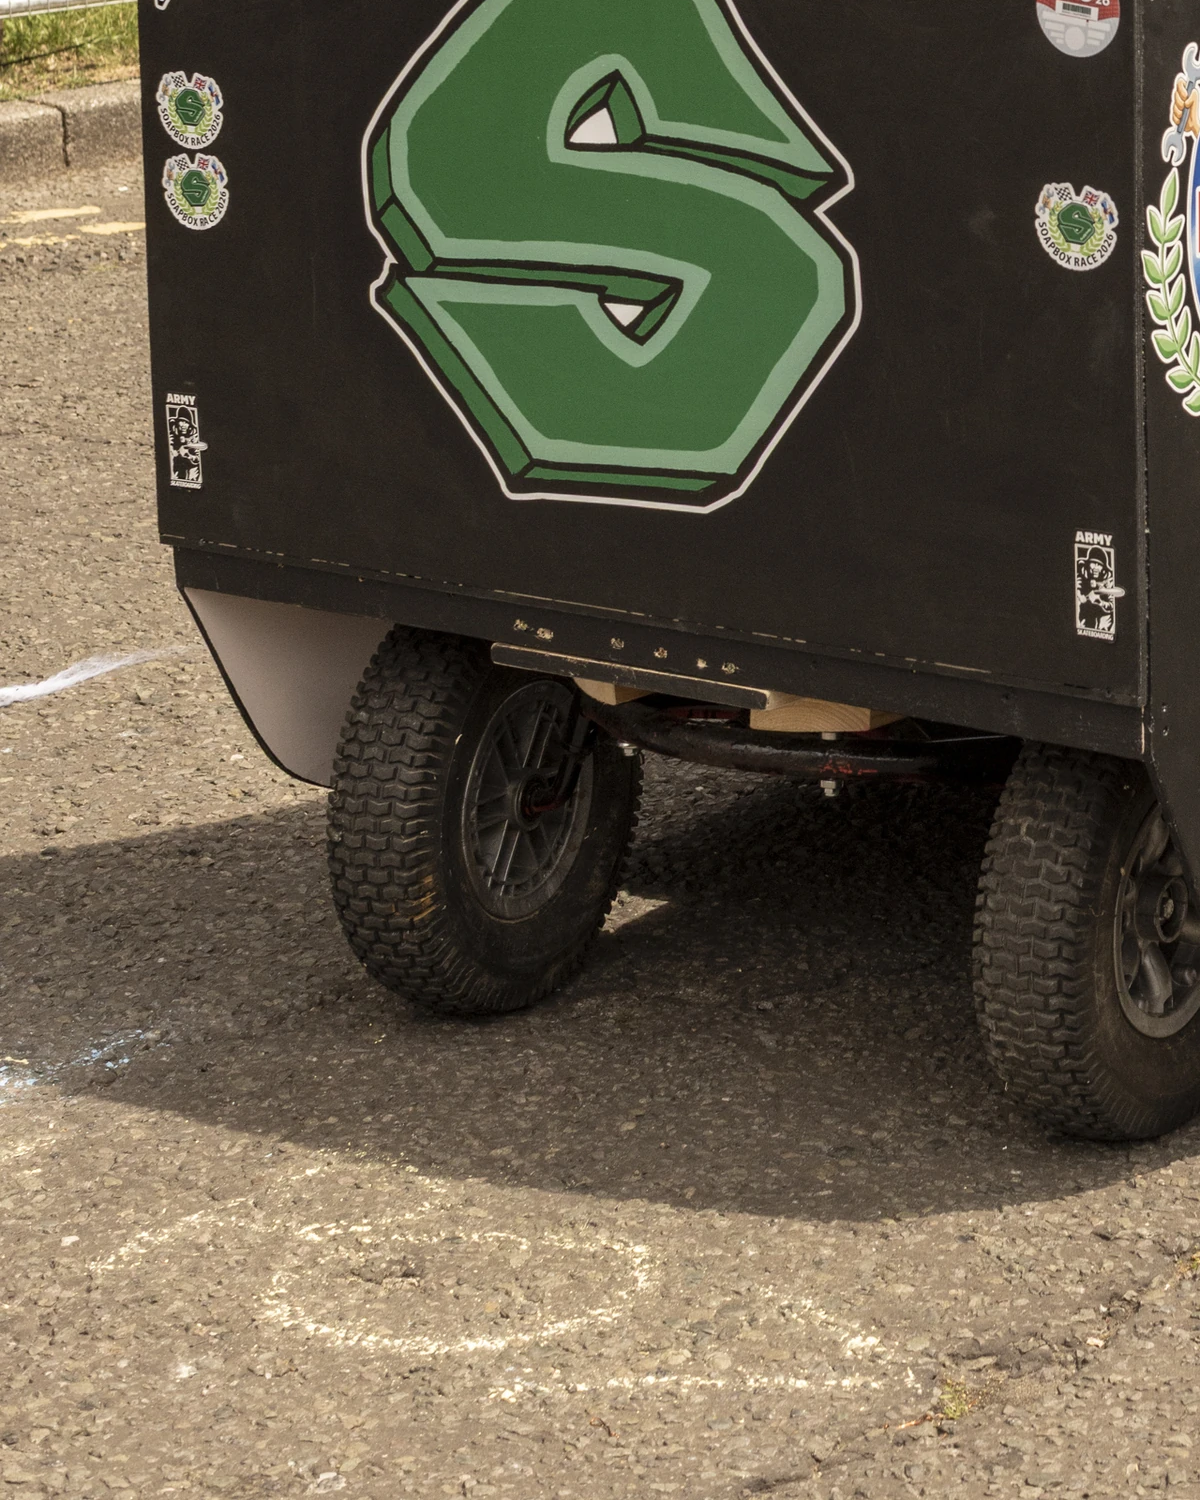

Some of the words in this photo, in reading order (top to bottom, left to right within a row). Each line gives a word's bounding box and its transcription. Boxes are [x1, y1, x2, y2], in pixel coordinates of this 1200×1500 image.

[160, 107, 189, 145] SOAPBOX
[191, 133, 210, 146] RACE
[209, 114, 221, 137] 2026
[167, 192, 198, 227] SOAPBOX
[200, 213, 217, 227] RACE
[216, 191, 227, 215] 2026
[1038, 221, 1072, 265] SOAPBOX
[1073, 253, 1098, 267] RACE
[1097, 233, 1114, 259] 2026
[166, 393, 196, 406] ARMY
[1075, 530, 1113, 546] ARMY
